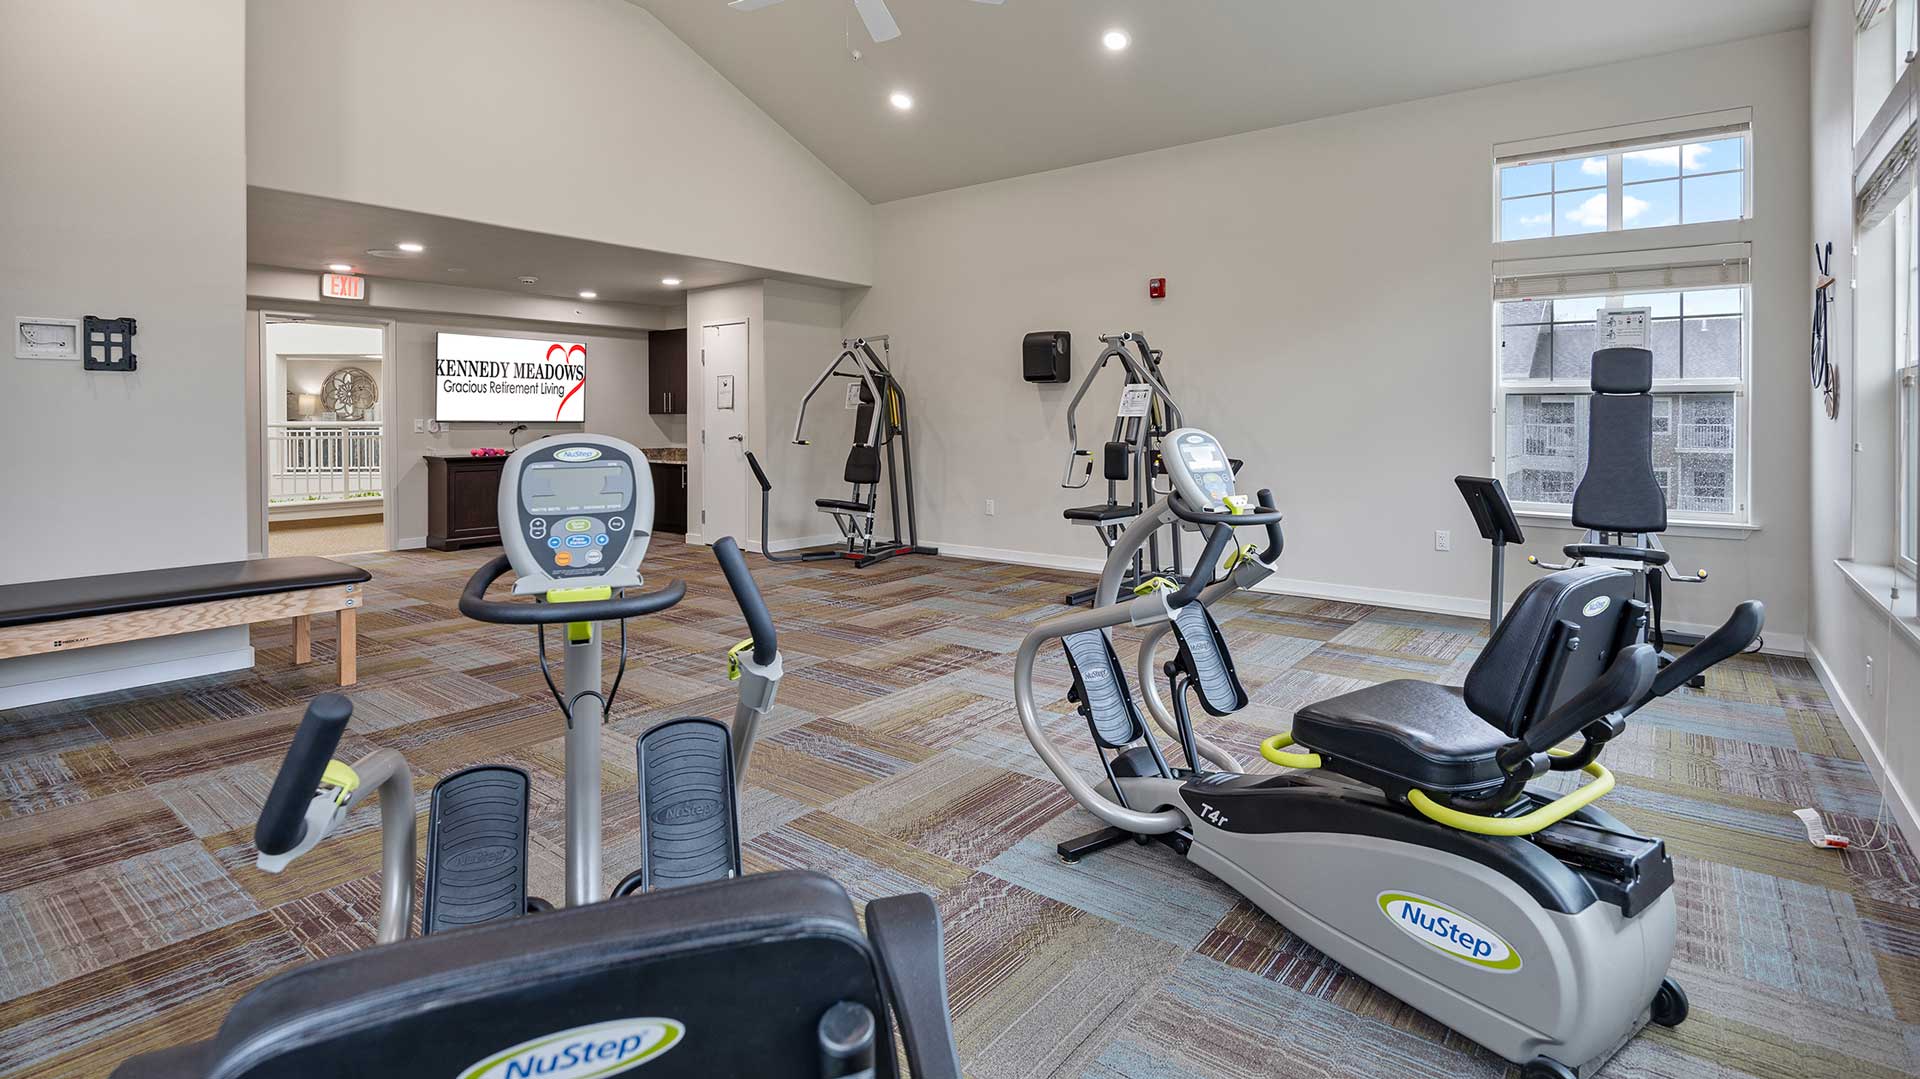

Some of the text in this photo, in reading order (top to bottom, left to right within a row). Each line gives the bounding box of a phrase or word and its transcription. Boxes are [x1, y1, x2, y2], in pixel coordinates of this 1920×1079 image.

[331, 273, 359, 297] EXIT
[436, 359, 584, 381] KENNEDY MEADOWS
[443, 379, 565, 398] Gracious Retirement Living
[1200, 802, 1229, 827] T4r
[1401, 902, 1492, 958] NuStep
[505, 1034, 641, 1079] NuStep
